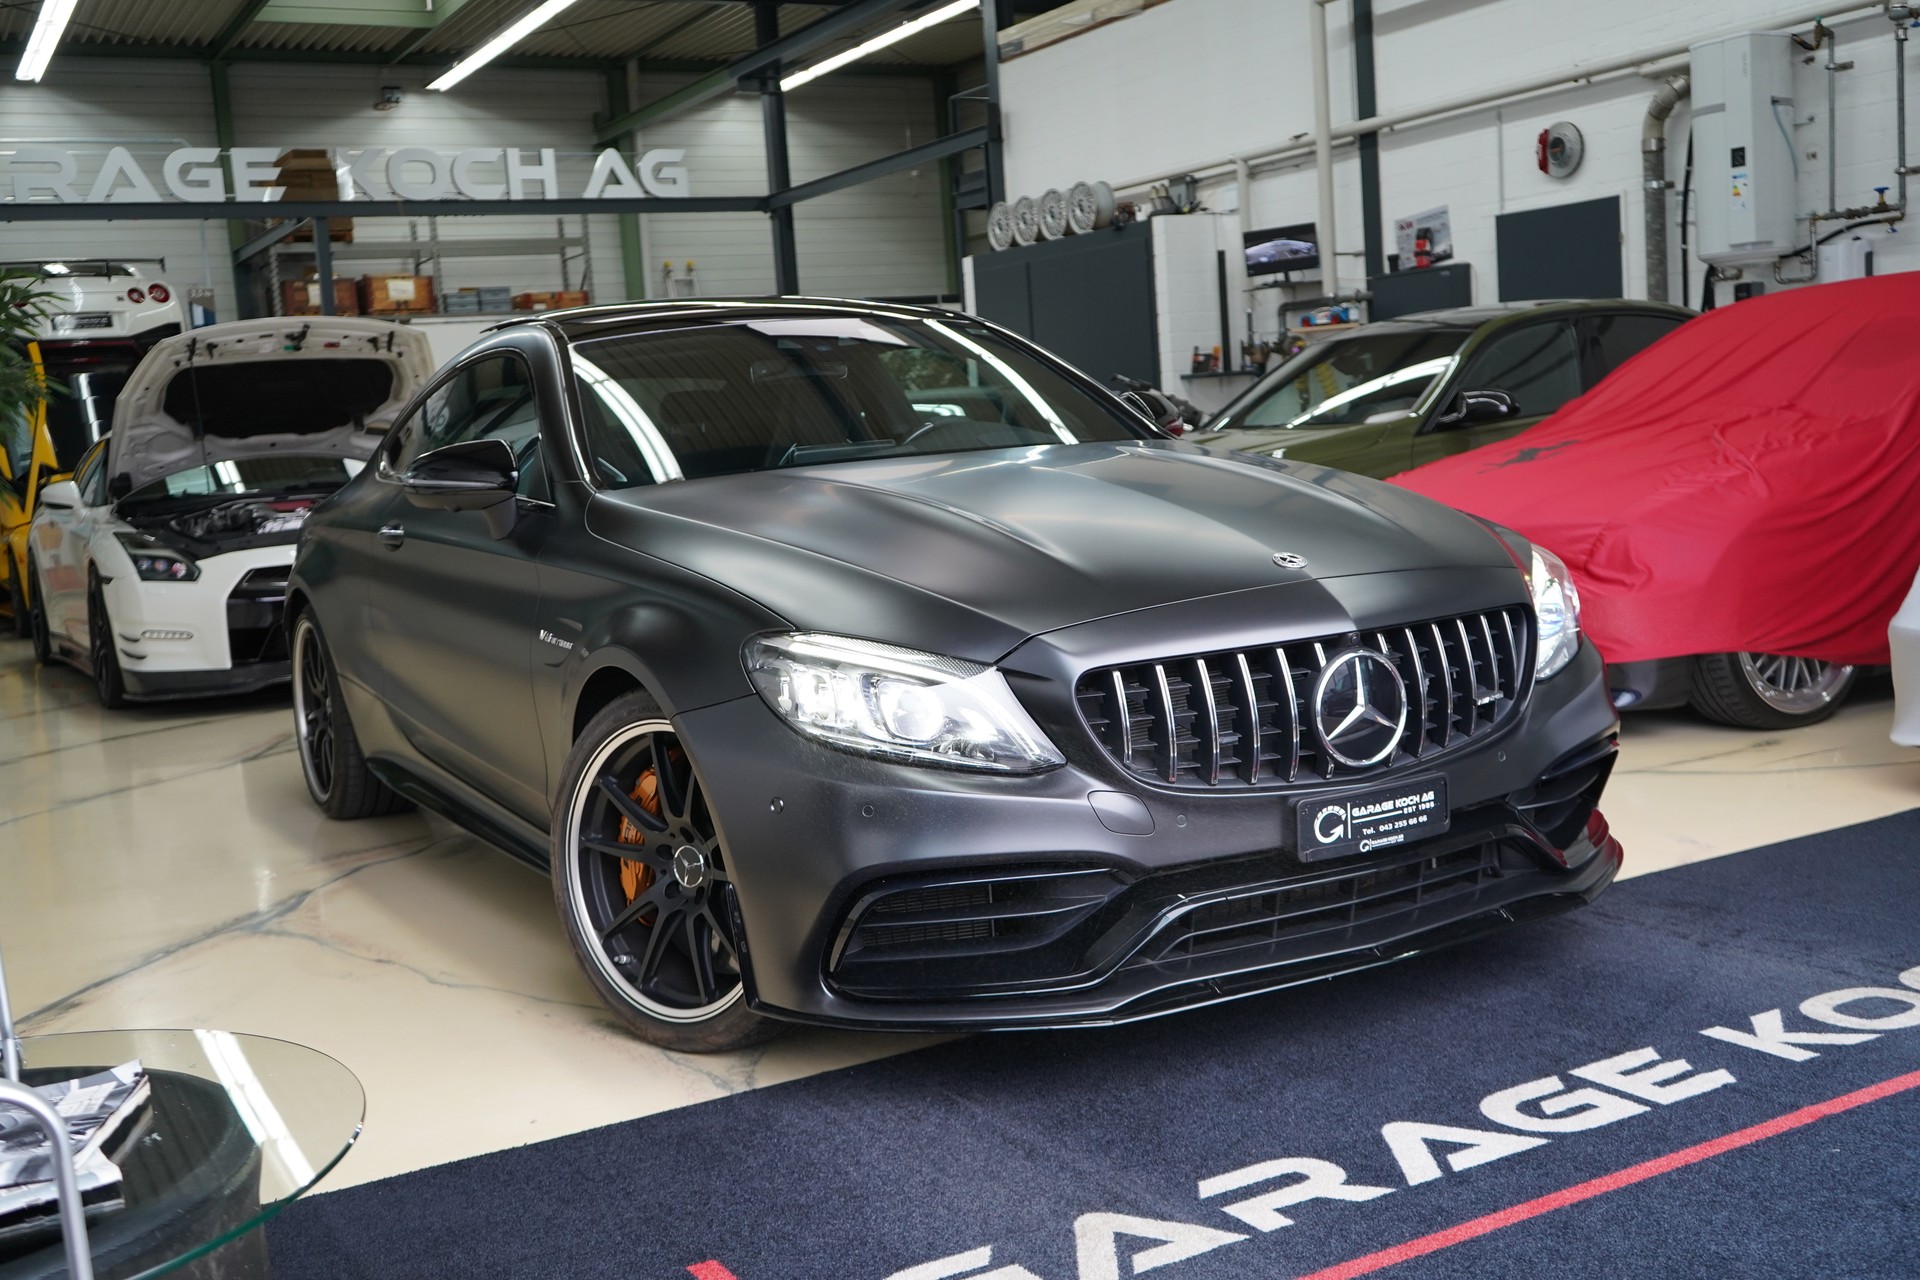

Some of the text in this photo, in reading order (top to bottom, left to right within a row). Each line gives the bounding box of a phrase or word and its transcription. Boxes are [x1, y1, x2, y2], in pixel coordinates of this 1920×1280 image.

[335, 147, 559, 201] KOCH
[582, 147, 690, 199] AG
[1352, 790, 1435, 817] GARAGE KOCH AG
[1404, 806, 1416, 814] EST
[1362, 828, 1376, 836] Tel.
[1379, 824, 1393, 832] 043
[1408, 817, 1418, 825] 66
[1418, 814, 1428, 823] 66
[1699, 966, 1920, 1063] KO
